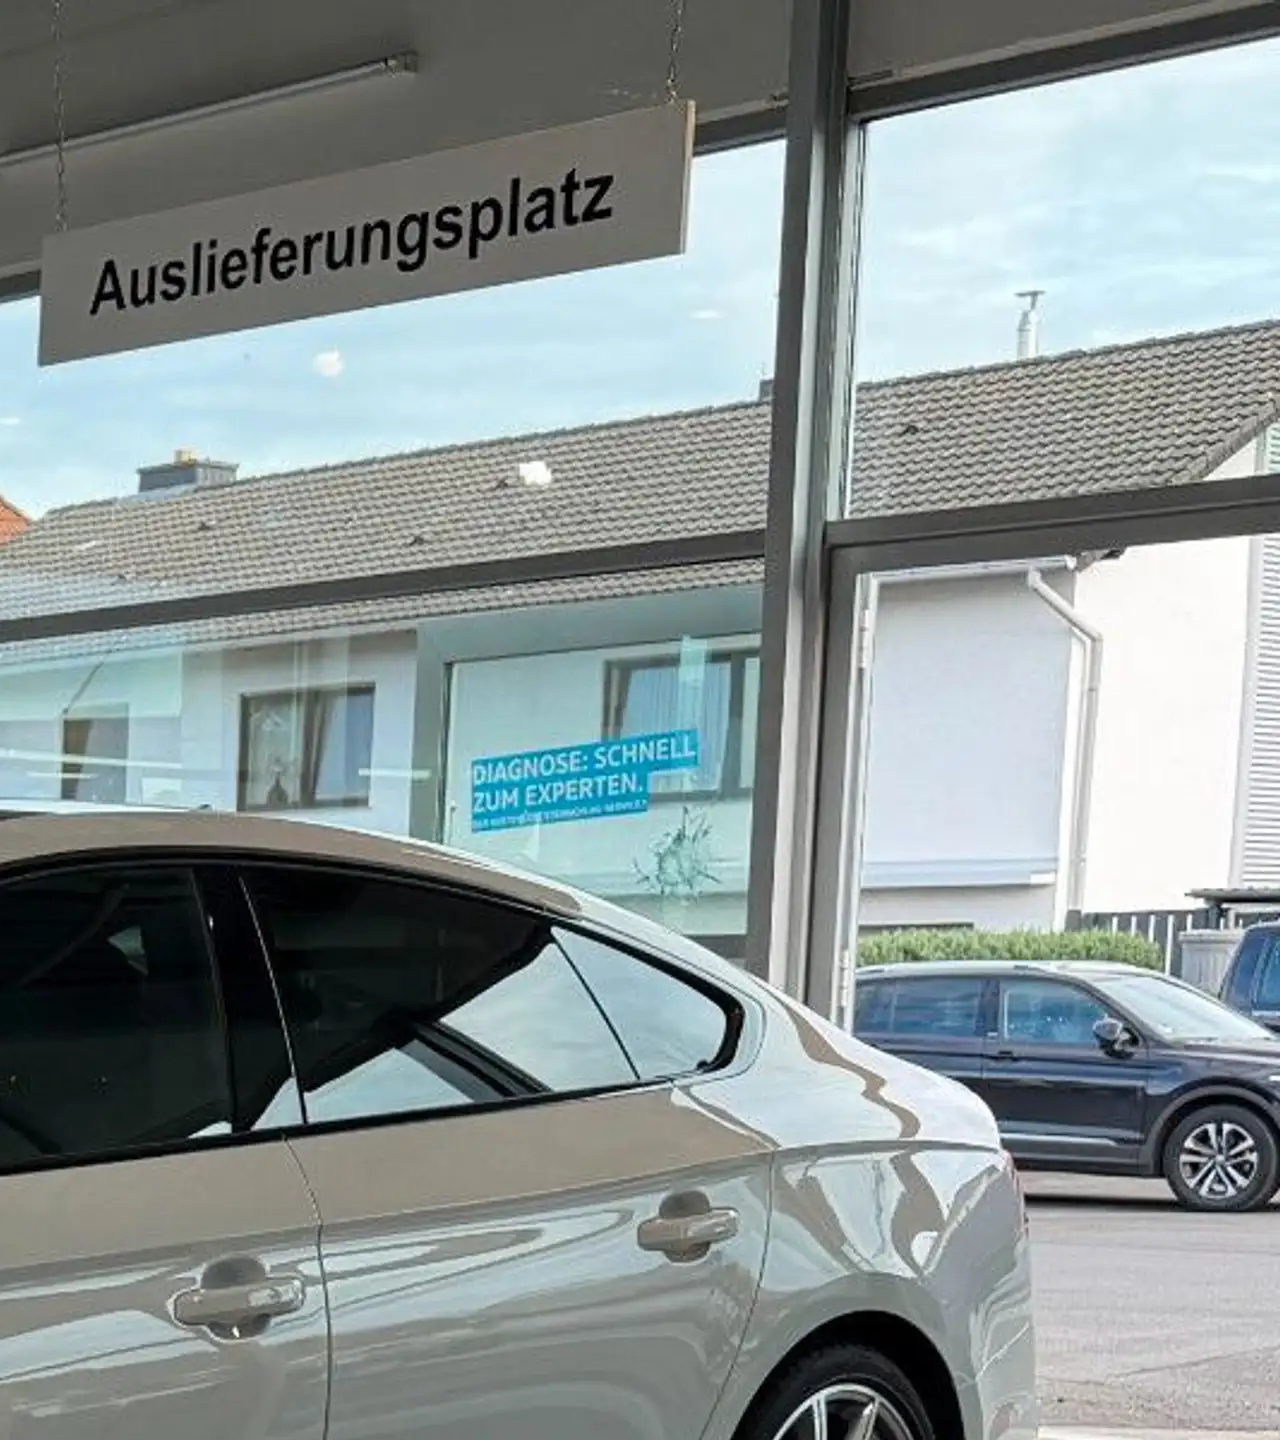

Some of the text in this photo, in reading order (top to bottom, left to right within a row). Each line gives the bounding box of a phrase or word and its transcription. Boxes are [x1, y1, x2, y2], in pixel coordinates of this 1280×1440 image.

[89, 166, 614, 315] Auslieferungsplatz
[472, 734, 696, 786] DIAGNOSE: SCHNELL
[472, 772, 644, 813] ZUM EXPERTEN.
